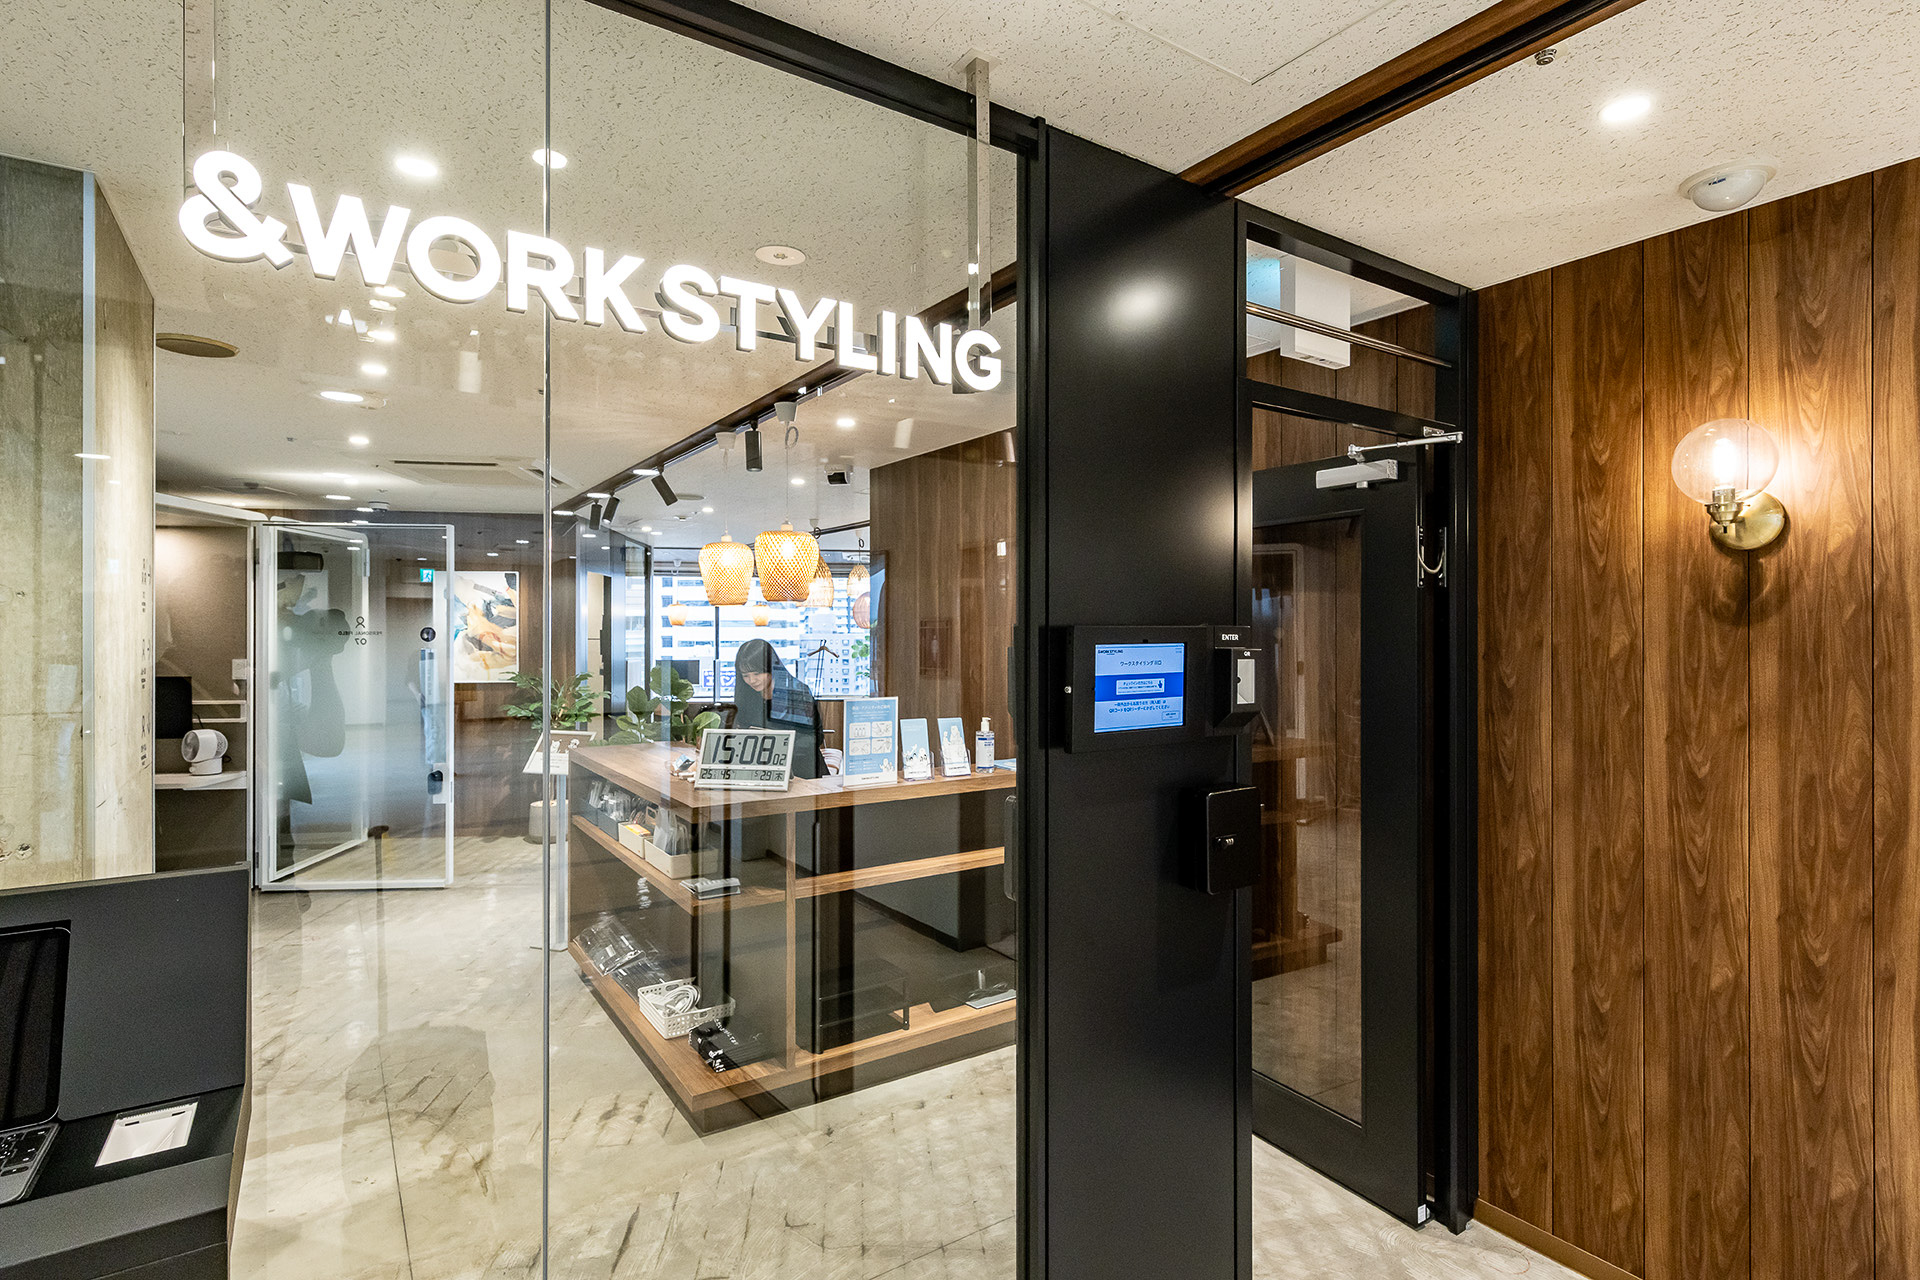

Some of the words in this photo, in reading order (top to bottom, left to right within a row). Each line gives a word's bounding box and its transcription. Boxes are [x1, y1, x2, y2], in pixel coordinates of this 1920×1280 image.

[657, 263, 1002, 393] STYLING
[1221, 633, 1239, 641] ENTER
[711, 734, 777, 765] 15:08
